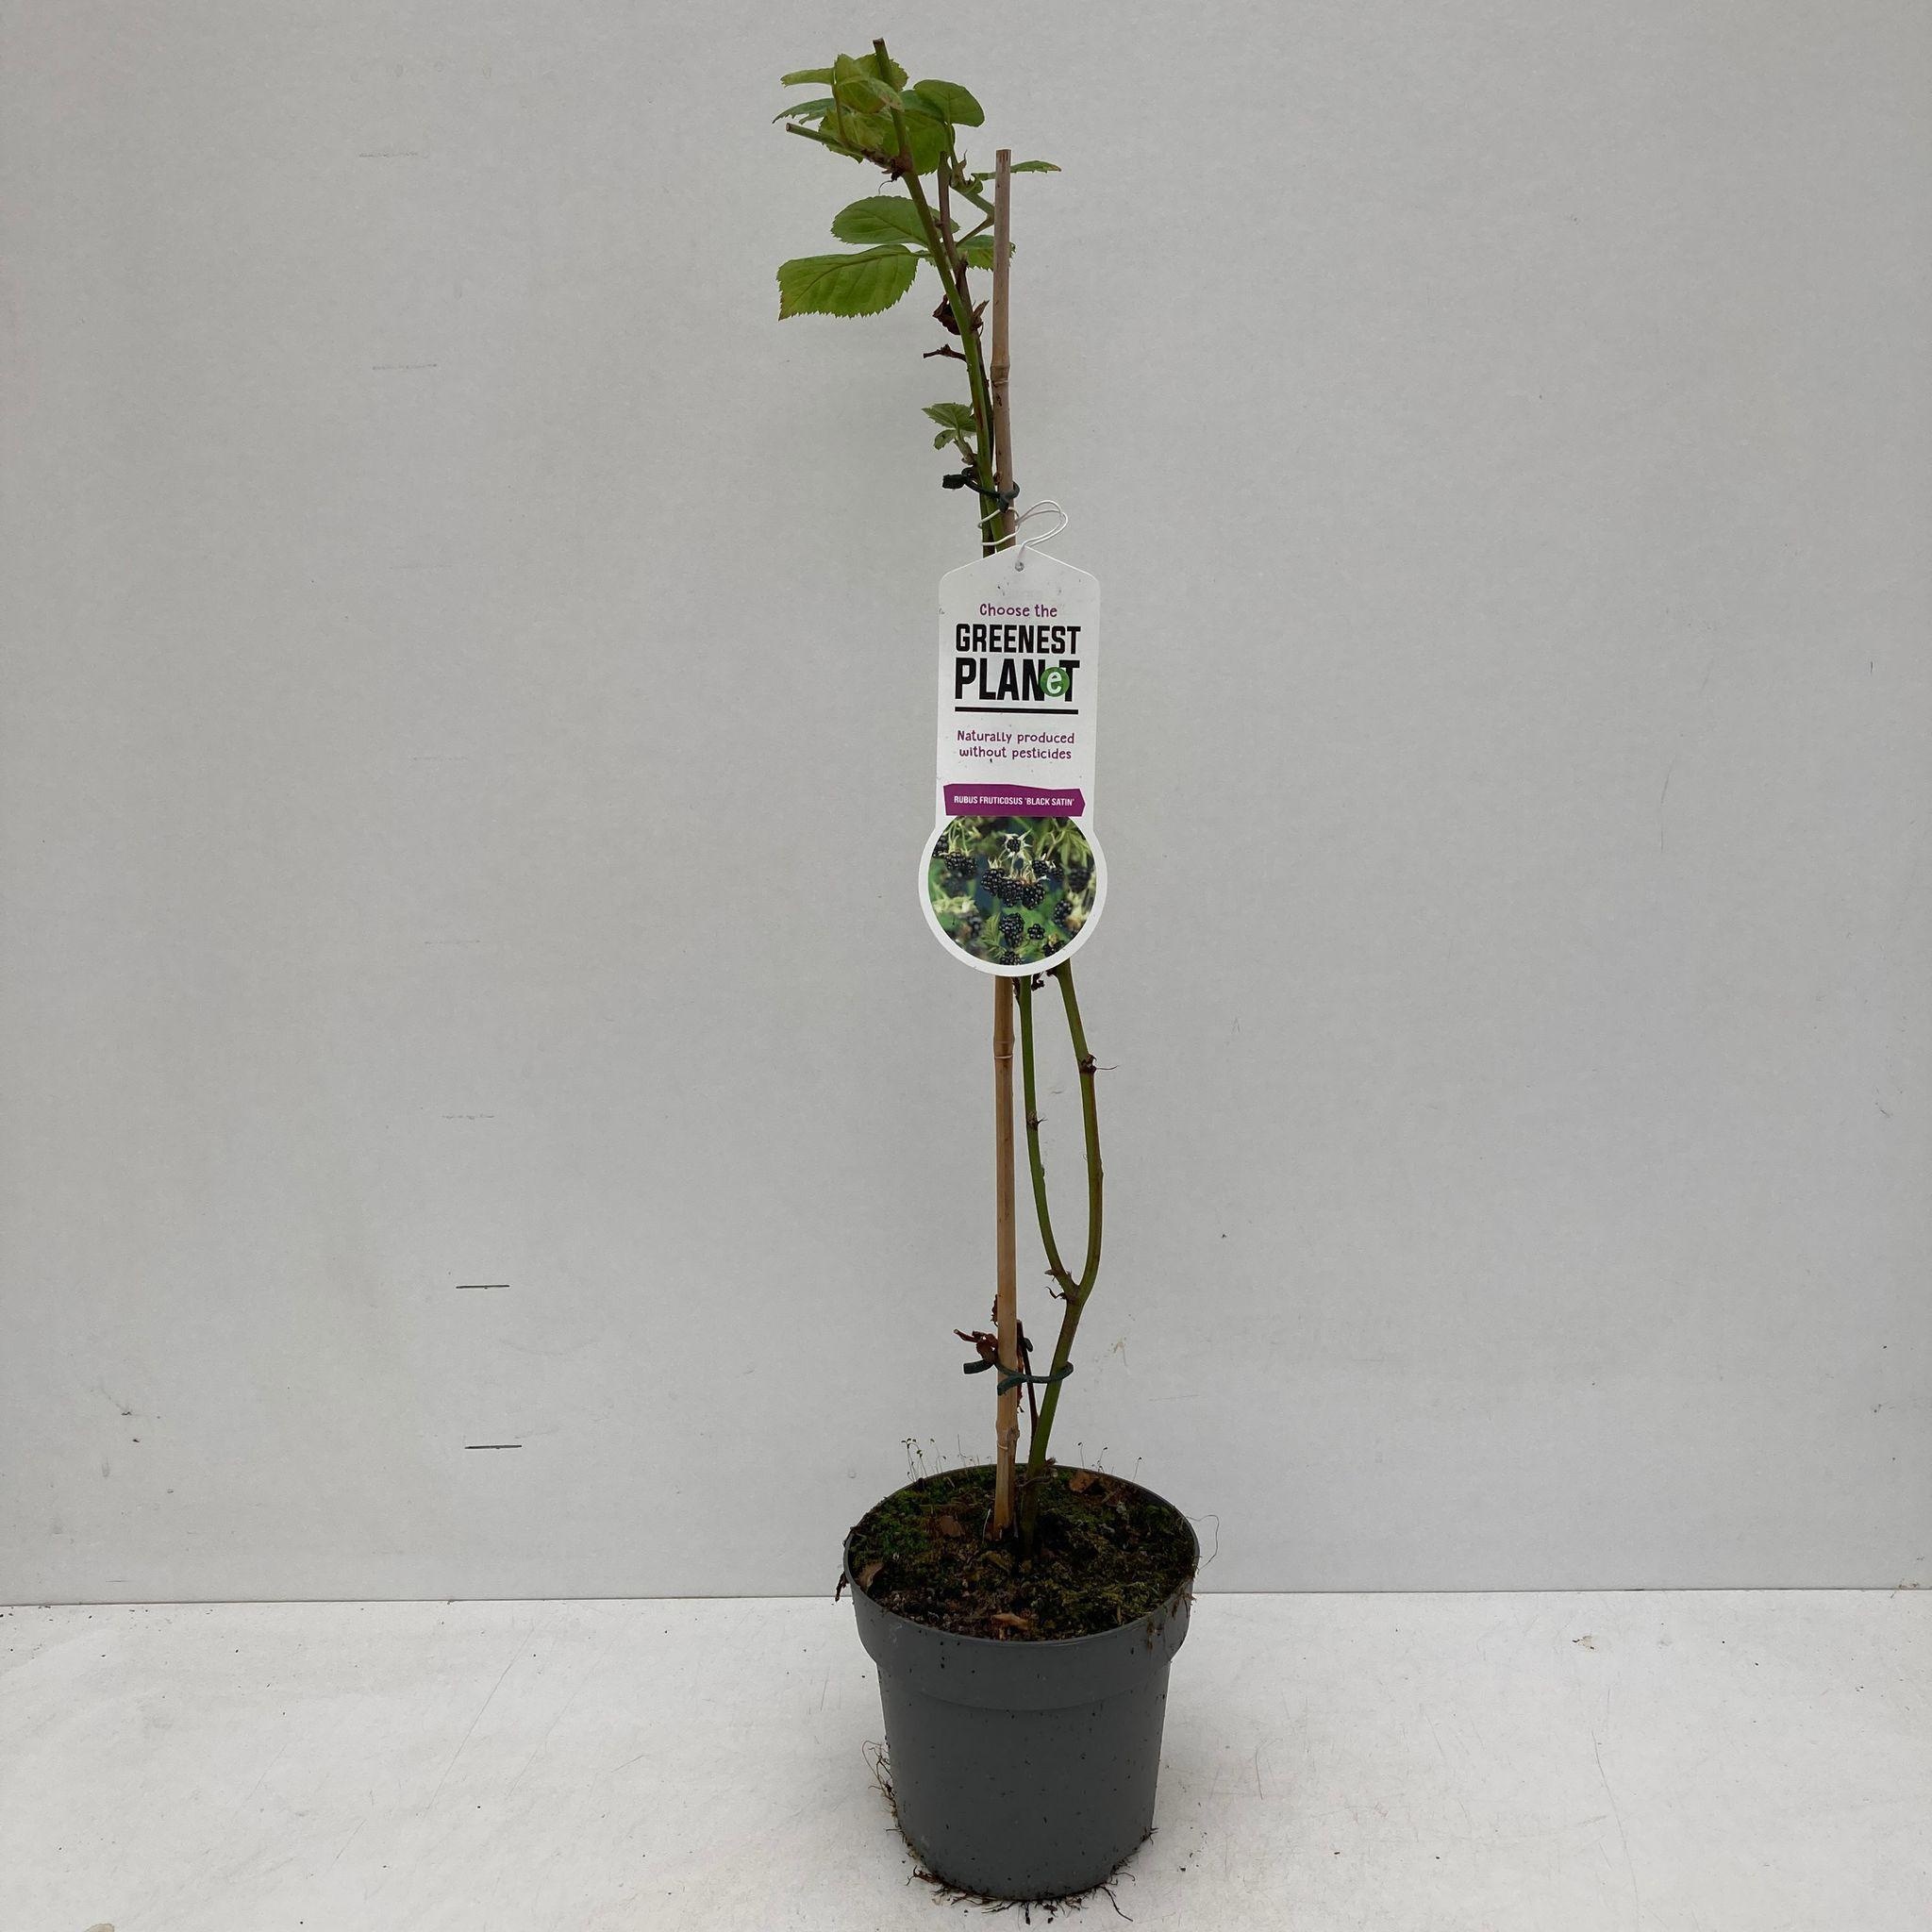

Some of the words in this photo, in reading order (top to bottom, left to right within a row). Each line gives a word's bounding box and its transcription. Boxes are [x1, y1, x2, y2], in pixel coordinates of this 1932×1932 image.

[979, 603, 1030, 617] Choose
[1034, 604, 1058, 618] the
[956, 623, 1081, 655] GREENEST
[957, 729, 1012, 743] Naturally
[1017, 732, 1074, 744] produced
[958, 746, 1007, 758] without
[1011, 747, 1072, 759] pesticides
[954, 795, 978, 804] RUBUS
[979, 796, 1023, 805] FRUTICOSUS
